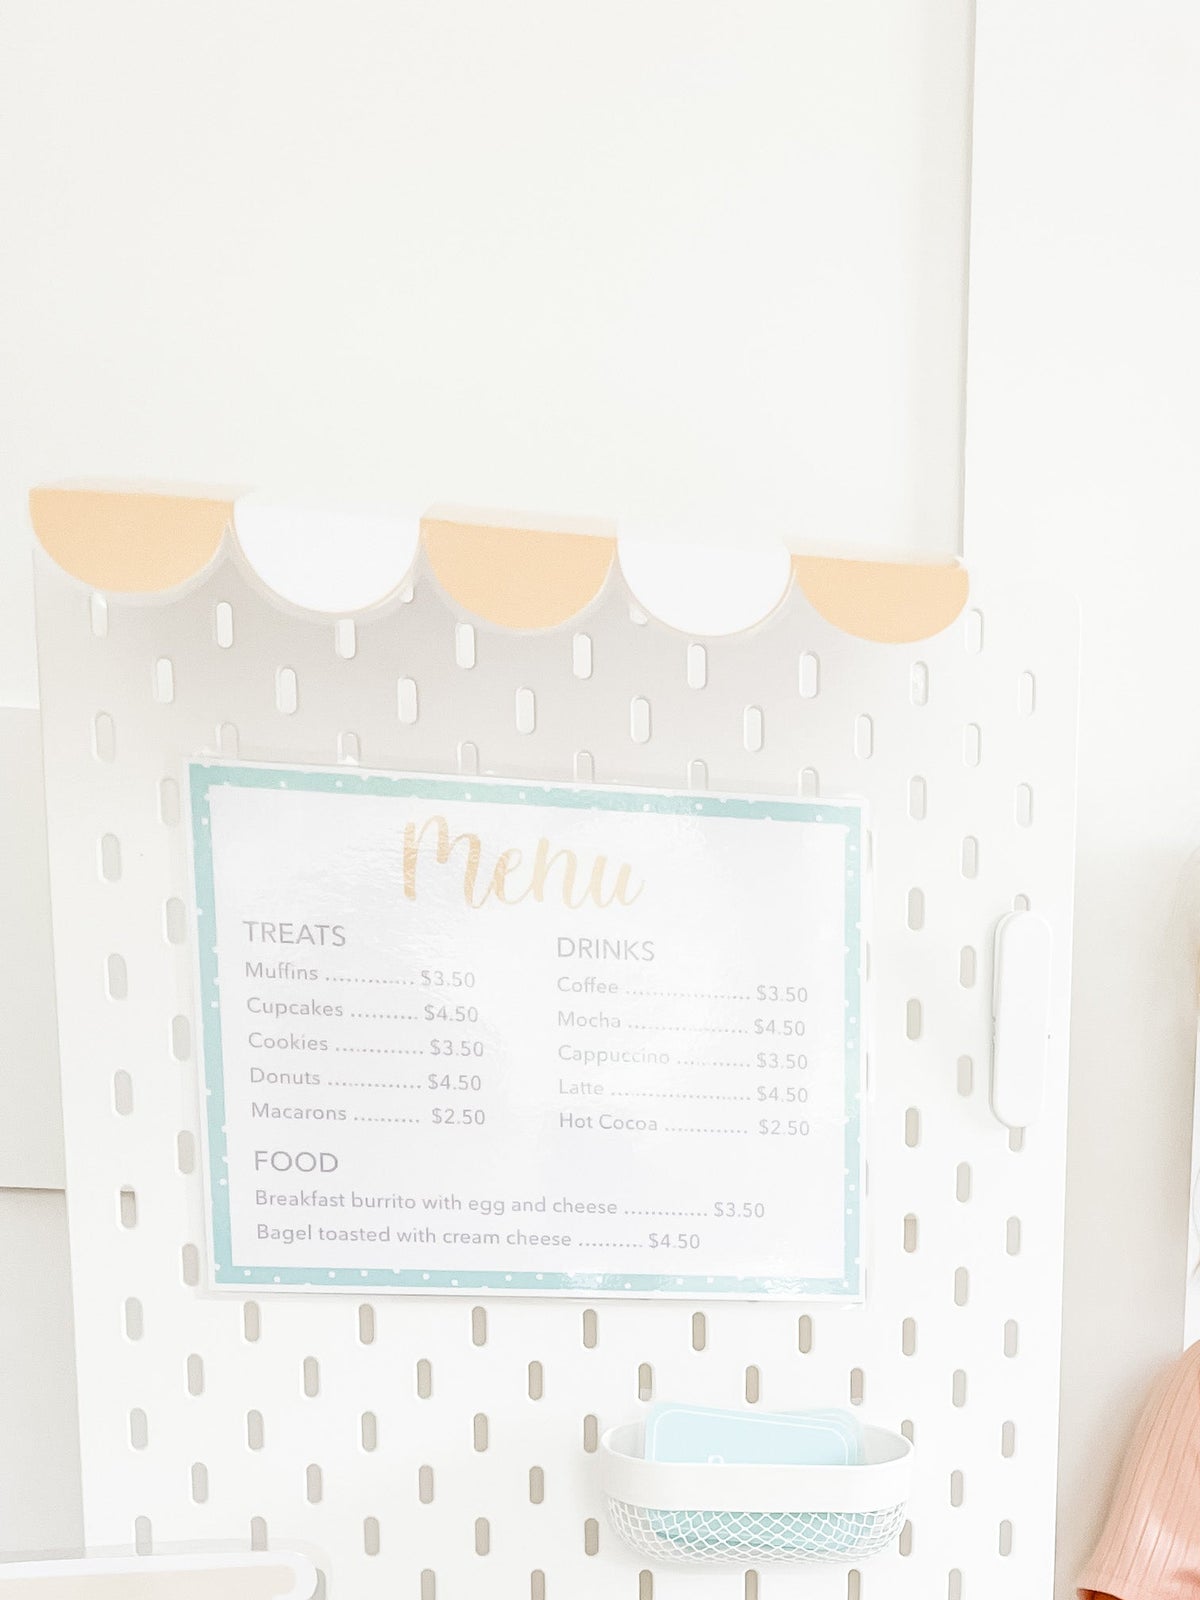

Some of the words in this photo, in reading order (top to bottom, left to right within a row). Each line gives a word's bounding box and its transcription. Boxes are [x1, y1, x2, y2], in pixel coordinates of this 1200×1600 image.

[402, 814, 647, 910] Menu
[242, 920, 347, 947] TREATS
[557, 936, 655, 962] DRINKS
[245, 961, 319, 982] Muffins
[420, 969, 476, 989] $3.50
[556, 976, 619, 994] Coffee
[755, 984, 809, 1003] $3.50
[246, 997, 344, 1019] Cupcakes
[424, 1003, 479, 1023] $4.50
[557, 1010, 622, 1029] Mocha
[753, 1018, 806, 1037] $4.50
[248, 1032, 329, 1051] Cookies
[429, 1038, 484, 1057] $3.50
[557, 1044, 670, 1066] Cappuccino
[755, 1052, 809, 1070] $3.50
[249, 1067, 321, 1086] Donuts
[427, 1073, 482, 1092] $4.50
[558, 1078, 604, 1096] Latte
[755, 1085, 808, 1104] $4.50
[251, 1102, 347, 1121] Macarons
[431, 1107, 486, 1126] $2.50
[559, 1112, 593, 1129] Hot
[598, 1113, 658, 1131] Cocoa
[758, 1118, 811, 1136] $2.50
[254, 1150, 339, 1173] FOOD
[255, 1189, 346, 1208] Breakfast
[351, 1191, 417, 1210] burrito
[421, 1193, 462, 1211] with
[467, 1199, 506, 1216] egg
[511, 1196, 547, 1213] and
[552, 1197, 618, 1215] cheese
[713, 1201, 766, 1219] $3.50
[256, 1224, 312, 1244] Bagel
[317, 1226, 391, 1243] toasted
[396, 1228, 437, 1244] with
[442, 1232, 501, 1246] cream
[505, 1229, 573, 1247] cheese
[648, 1232, 702, 1250] $4.50
